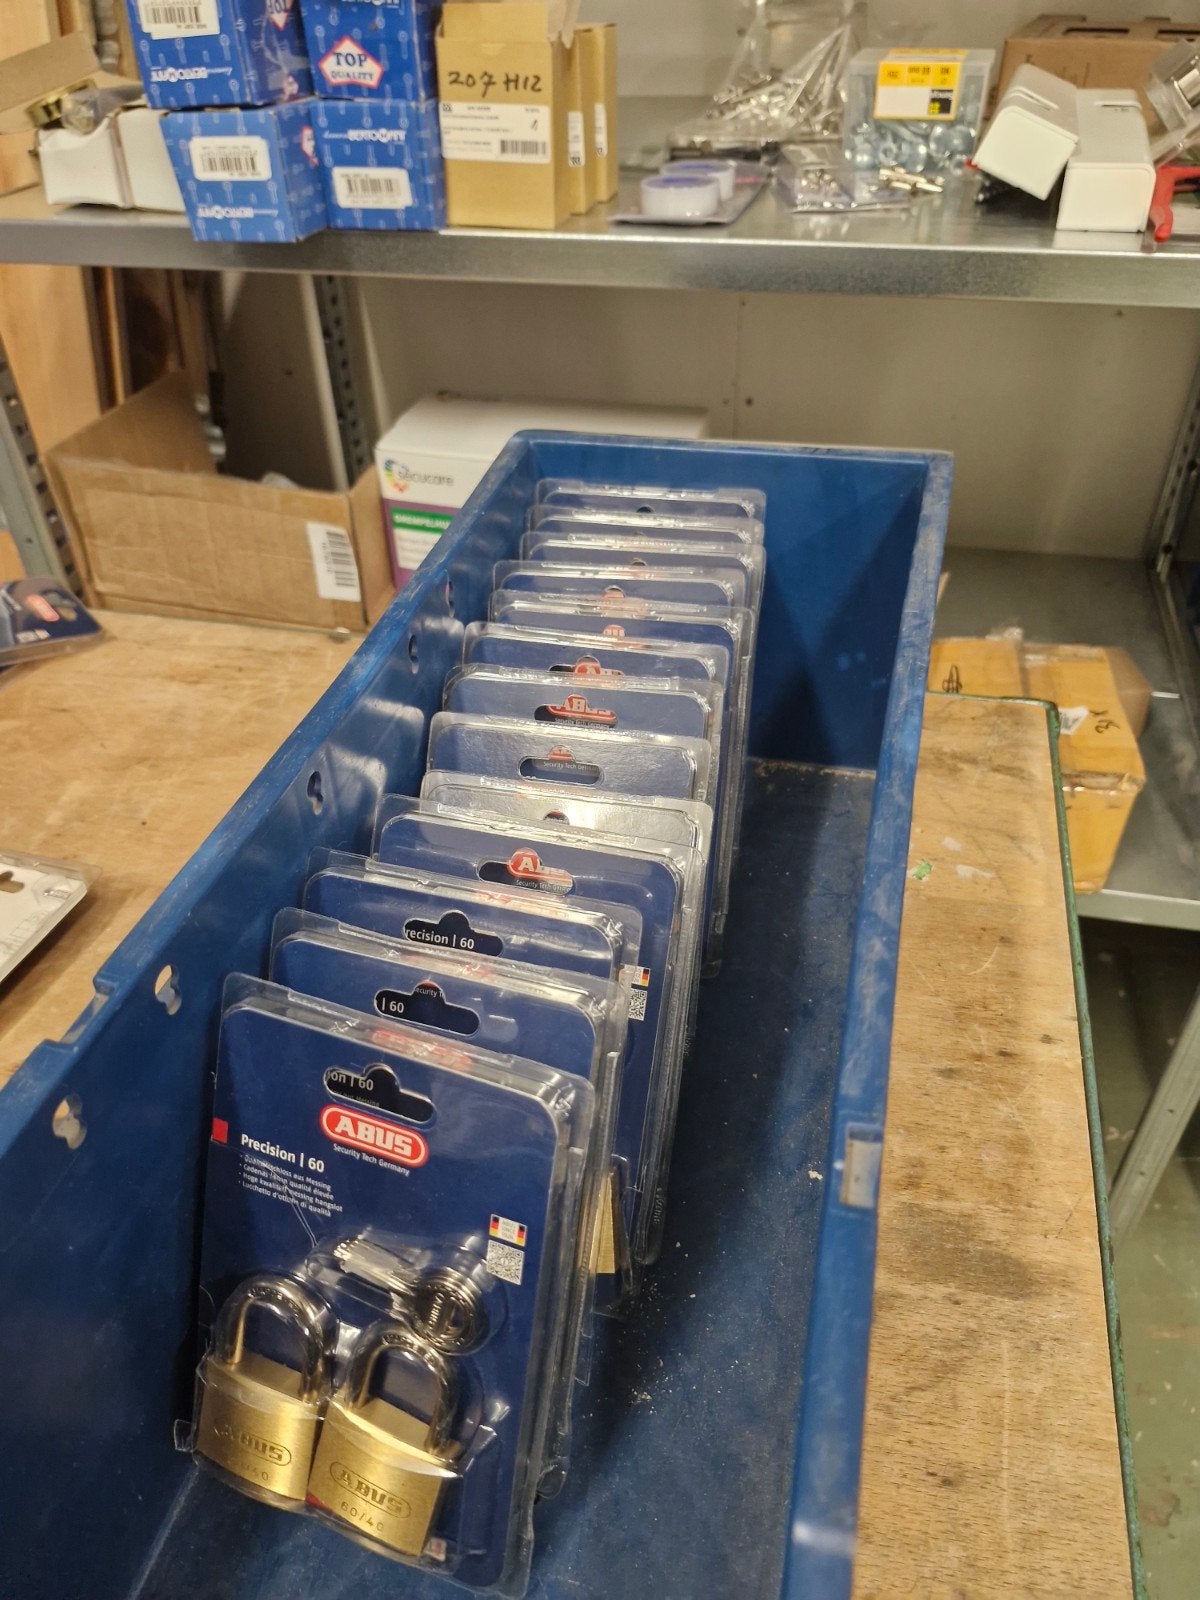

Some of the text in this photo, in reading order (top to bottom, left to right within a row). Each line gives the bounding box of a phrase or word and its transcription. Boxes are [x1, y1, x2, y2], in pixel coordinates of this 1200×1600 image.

[335, 52, 367, 67] TOP
[331, 70, 373, 80] QUALITY
[448, 70, 542, 98] 207 H12
[406, 929, 448, 945] recision
[460, 937, 475, 949] 60
[415, 987, 438, 998] ecurity
[389, 1001, 405, 1013] 60
[358, 1079, 374, 1091] 60
[334, 1115, 413, 1157] ABUS
[241, 1133, 296, 1163] Precision
[308, 1157, 325, 1173] 60
[333, 1143, 410, 1177] Security Tech Germany
[336, 1470, 403, 1513] ABUS
[341, 1502, 384, 1531] 60/40
